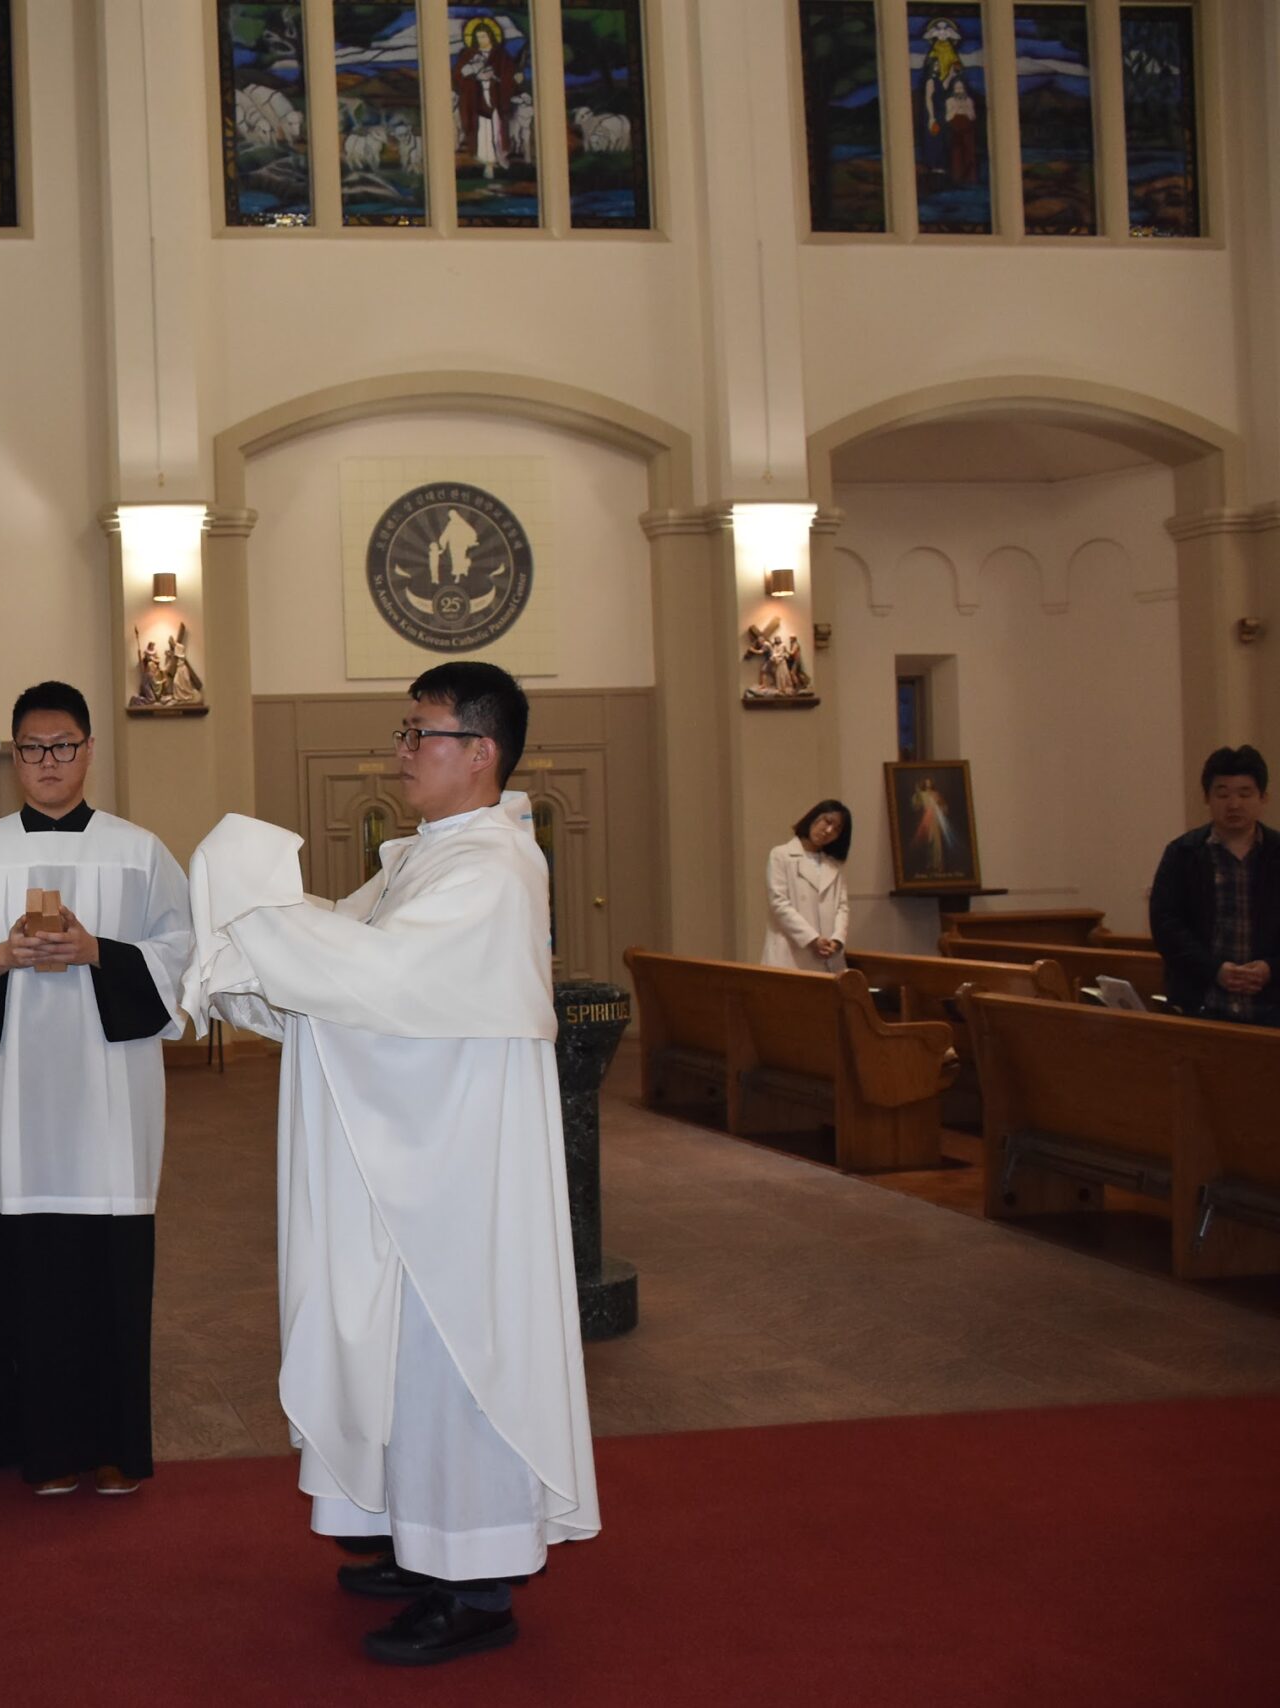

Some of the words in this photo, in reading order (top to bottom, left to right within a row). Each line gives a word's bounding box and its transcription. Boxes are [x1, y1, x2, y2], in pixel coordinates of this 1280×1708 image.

[377, 589, 399, 622] Andrew
[399, 620, 417, 637] Kim
[417, 631, 450, 647] Korean
[452, 630, 489, 647] Catholic
[489, 602, 517, 633] Pastoral
[513, 572, 529, 606] Center
[440, 597, 463, 613] 25
